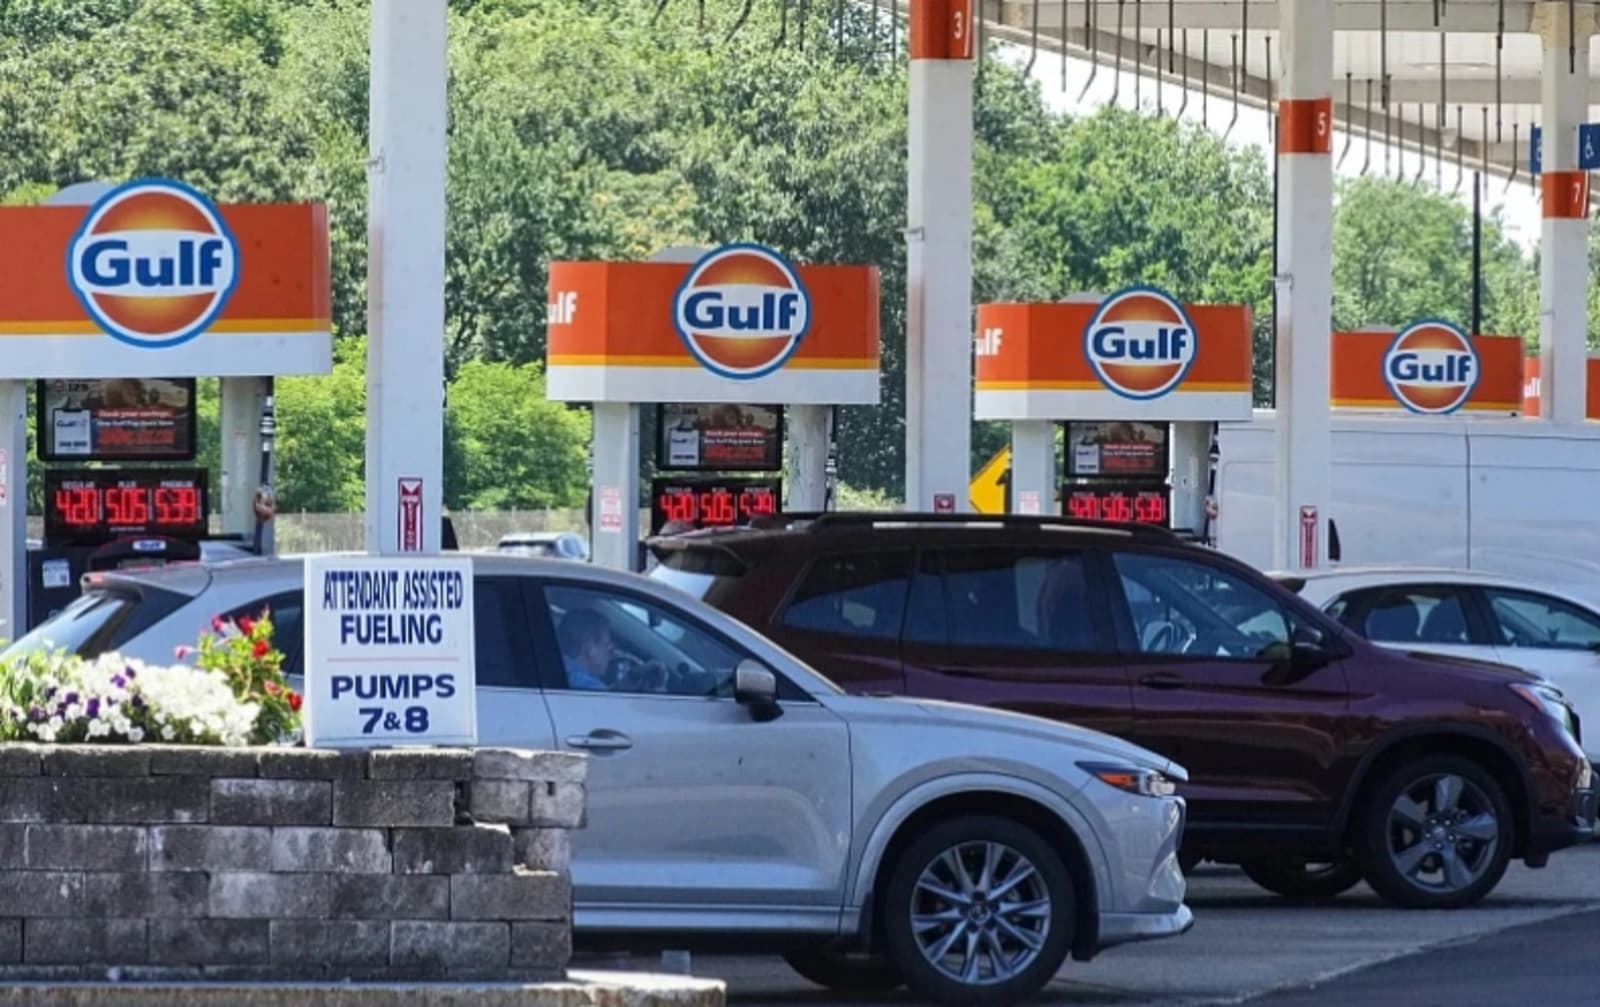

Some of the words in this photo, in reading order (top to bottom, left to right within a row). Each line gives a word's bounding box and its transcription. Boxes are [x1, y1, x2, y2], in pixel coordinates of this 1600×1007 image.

[954, 11, 963, 39] 3
[1317, 112, 1326, 136] 5
[1573, 182, 1581, 203] 7
[80, 239, 224, 287] Gulf
[547, 291, 577, 324] ulf
[683, 291, 799, 331] Gulf
[975, 328, 1003, 356] ulf
[1092, 327, 1187, 360] Gulf
[1389, 353, 1472, 382] Gulf
[56, 488, 98, 524] 420
[105, 488, 148, 524] 505
[154, 488, 197, 524] 539
[660, 492, 695, 522] 420
[700, 493, 735, 522] 505
[323, 571, 399, 609] ATTENDANT
[403, 571, 463, 609] ASSISTED
[340, 614, 443, 645] FUELING
[331, 674, 455, 700] PUMPS
[358, 706, 430, 734] 7&8
